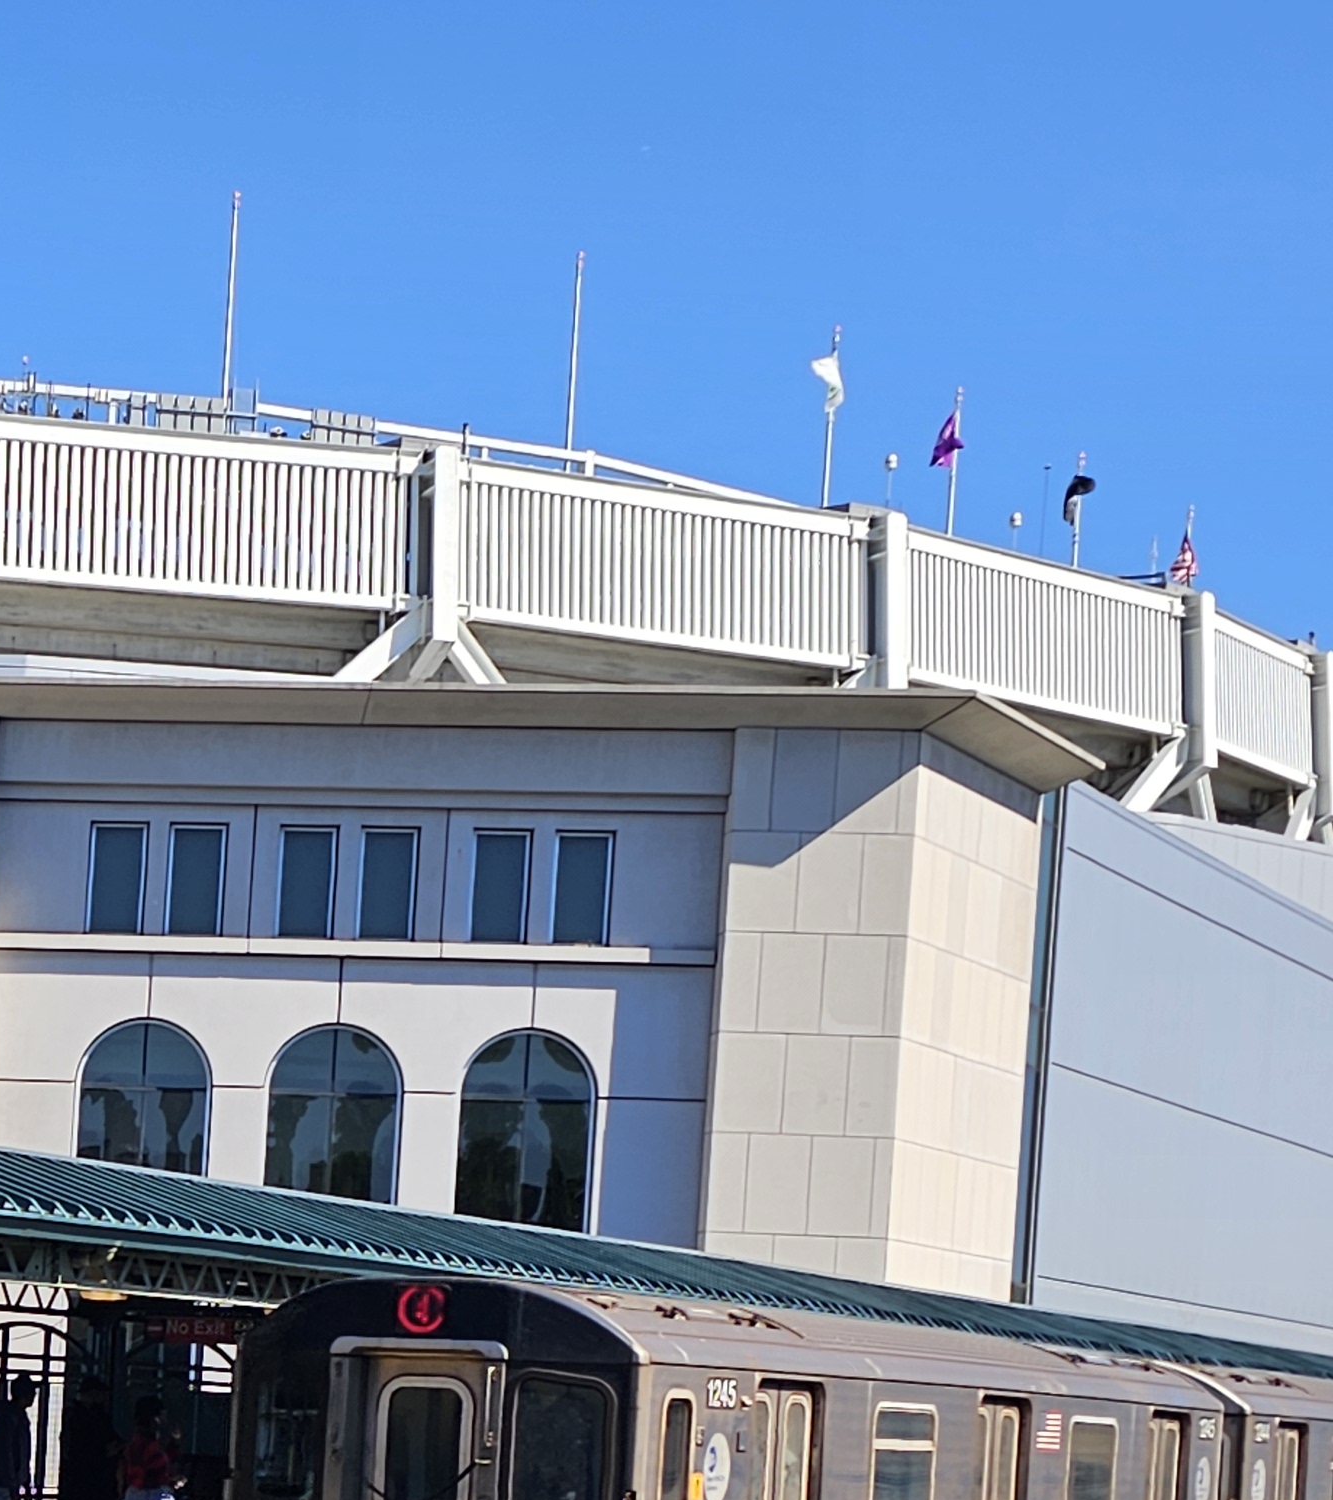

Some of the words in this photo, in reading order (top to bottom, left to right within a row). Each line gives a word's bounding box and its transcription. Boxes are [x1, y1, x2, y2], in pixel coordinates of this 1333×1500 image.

[165, 1318, 189, 1335] No
[194, 1319, 226, 1336] Exit
[707, 1378, 737, 1408] 1245
